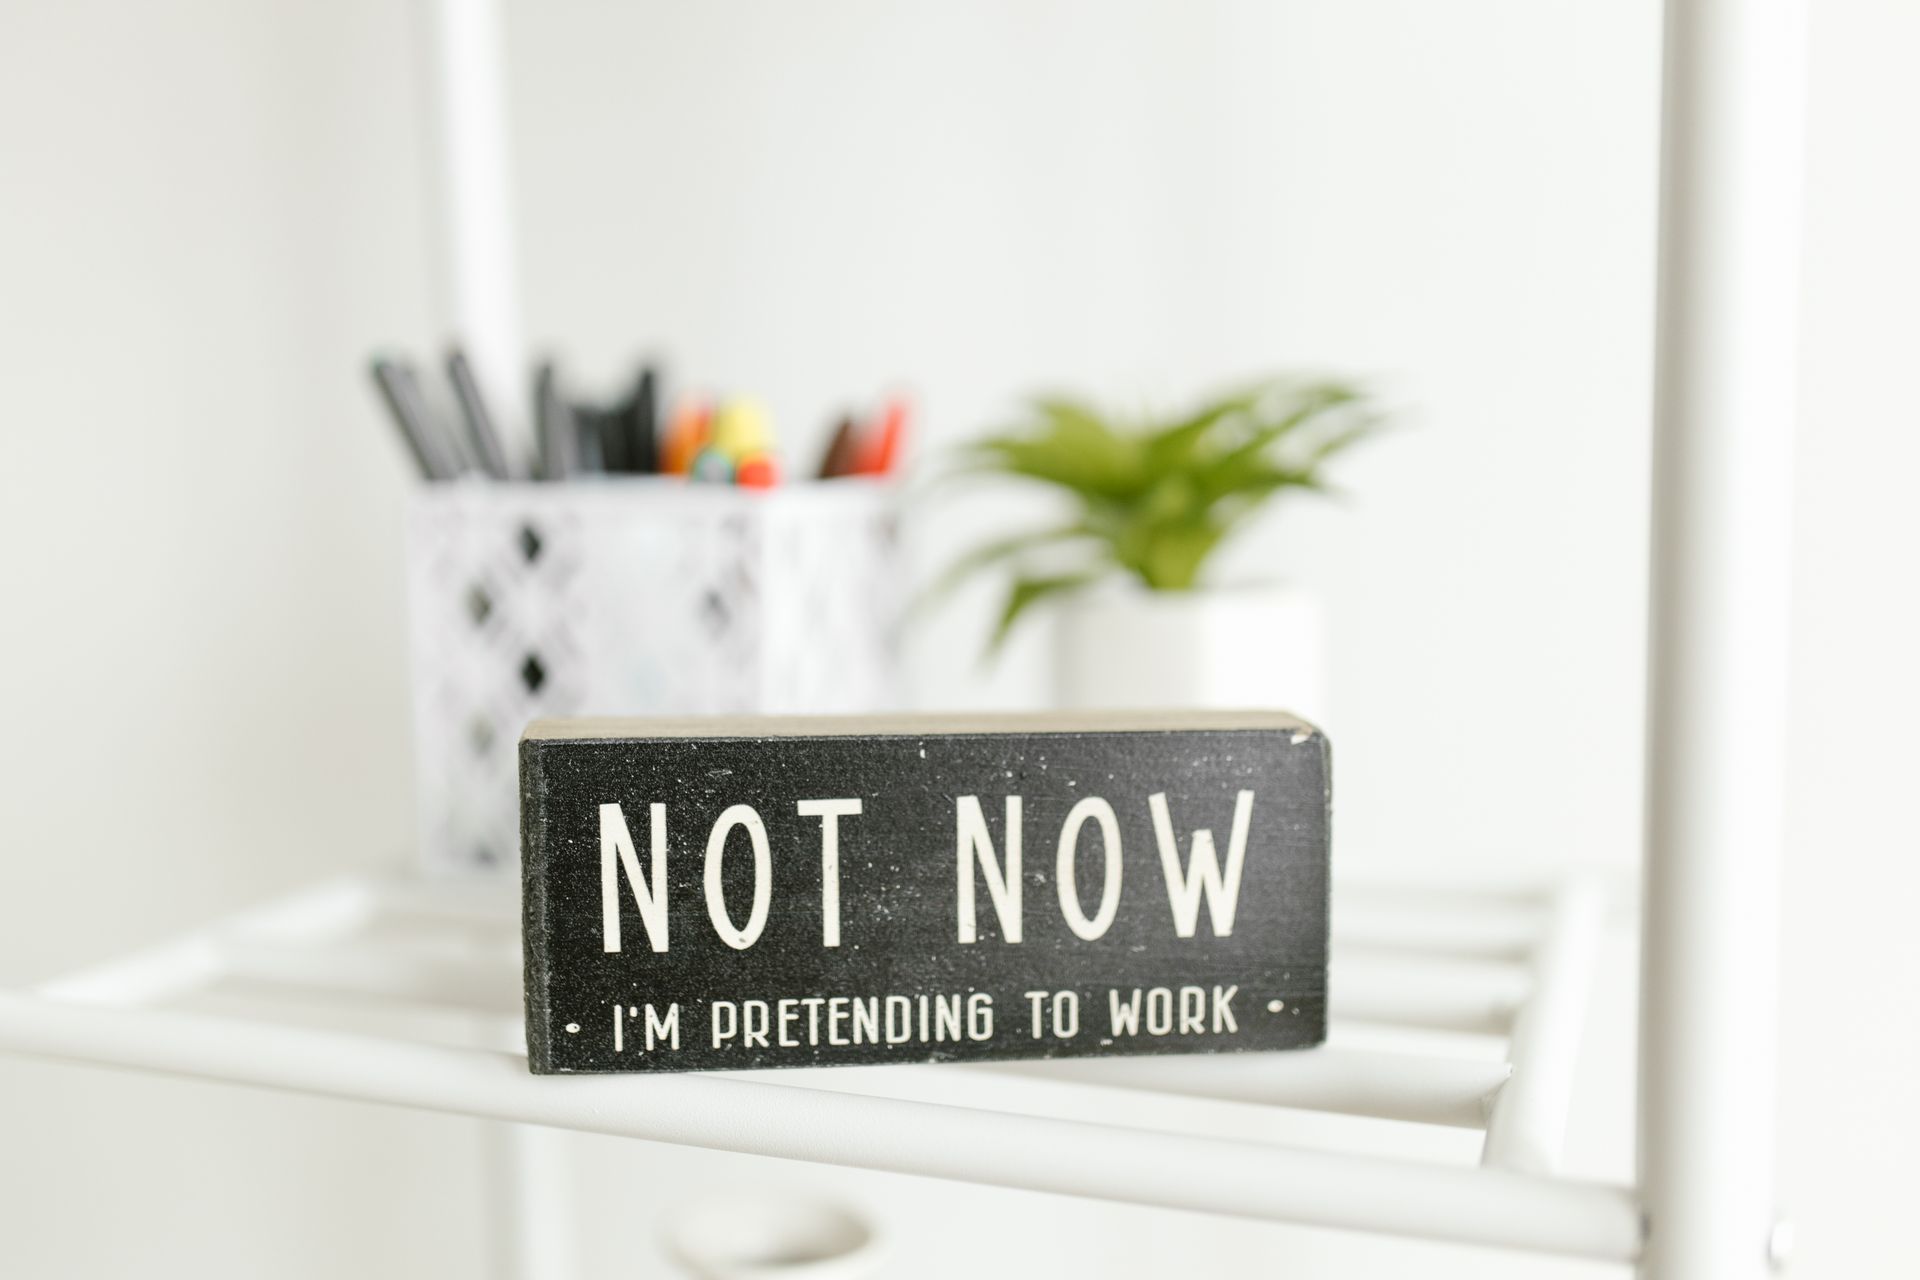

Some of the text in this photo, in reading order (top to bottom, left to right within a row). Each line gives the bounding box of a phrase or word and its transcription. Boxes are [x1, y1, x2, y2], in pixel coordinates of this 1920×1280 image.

[599, 789, 1255, 953] NOT NOW
[613, 985, 1239, 1051] I'M PRETENDING TO WORK
